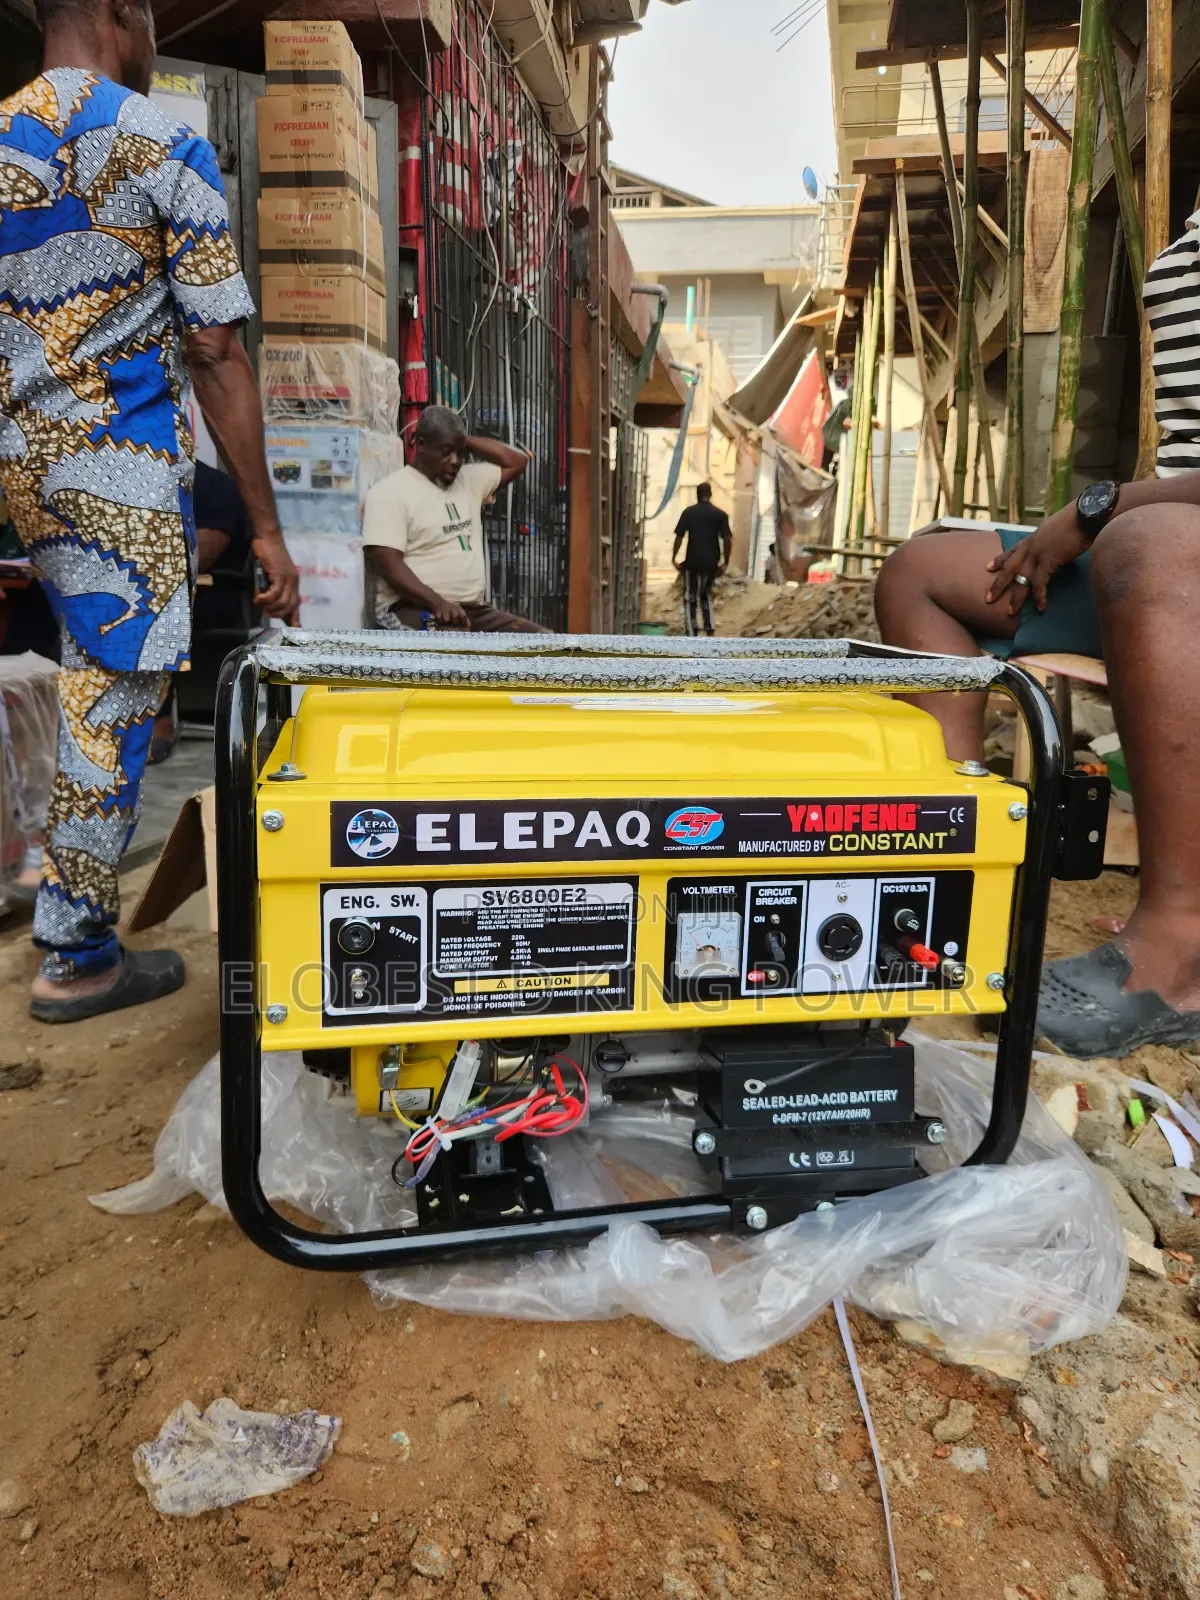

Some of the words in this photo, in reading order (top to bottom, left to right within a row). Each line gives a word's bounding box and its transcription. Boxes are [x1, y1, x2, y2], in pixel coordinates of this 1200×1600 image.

[415, 810, 651, 852] ELEPAQ
[738, 840, 812, 853] MANUFACTURED
[813, 839, 826, 852] BY
[682, 886, 736, 895] VOLTMETER
[758, 888, 793, 897] CIRCUIT
[340, 895, 380, 909] ENG.
[390, 894, 420, 908] SW.
[481, 887, 587, 907] SV6800E2
[755, 896, 798, 906] BREAKER
[753, 915, 766, 924] ON
[388, 925, 419, 945] START
[516, 977, 572, 988] CAUTION
[748, 973, 765, 981] OFF
[525, 991, 541, 999] DUE
[553, 989, 584, 997] DANGER
[596, 987, 626, 995] CARBON
[443, 1003, 483, 1011] MONOXIDE
[484, 1001, 526, 1009] POISONING
[742, 1092, 849, 1110] SEALED-LEAD-ACID
[849, 1089, 899, 1102] BATTERY
